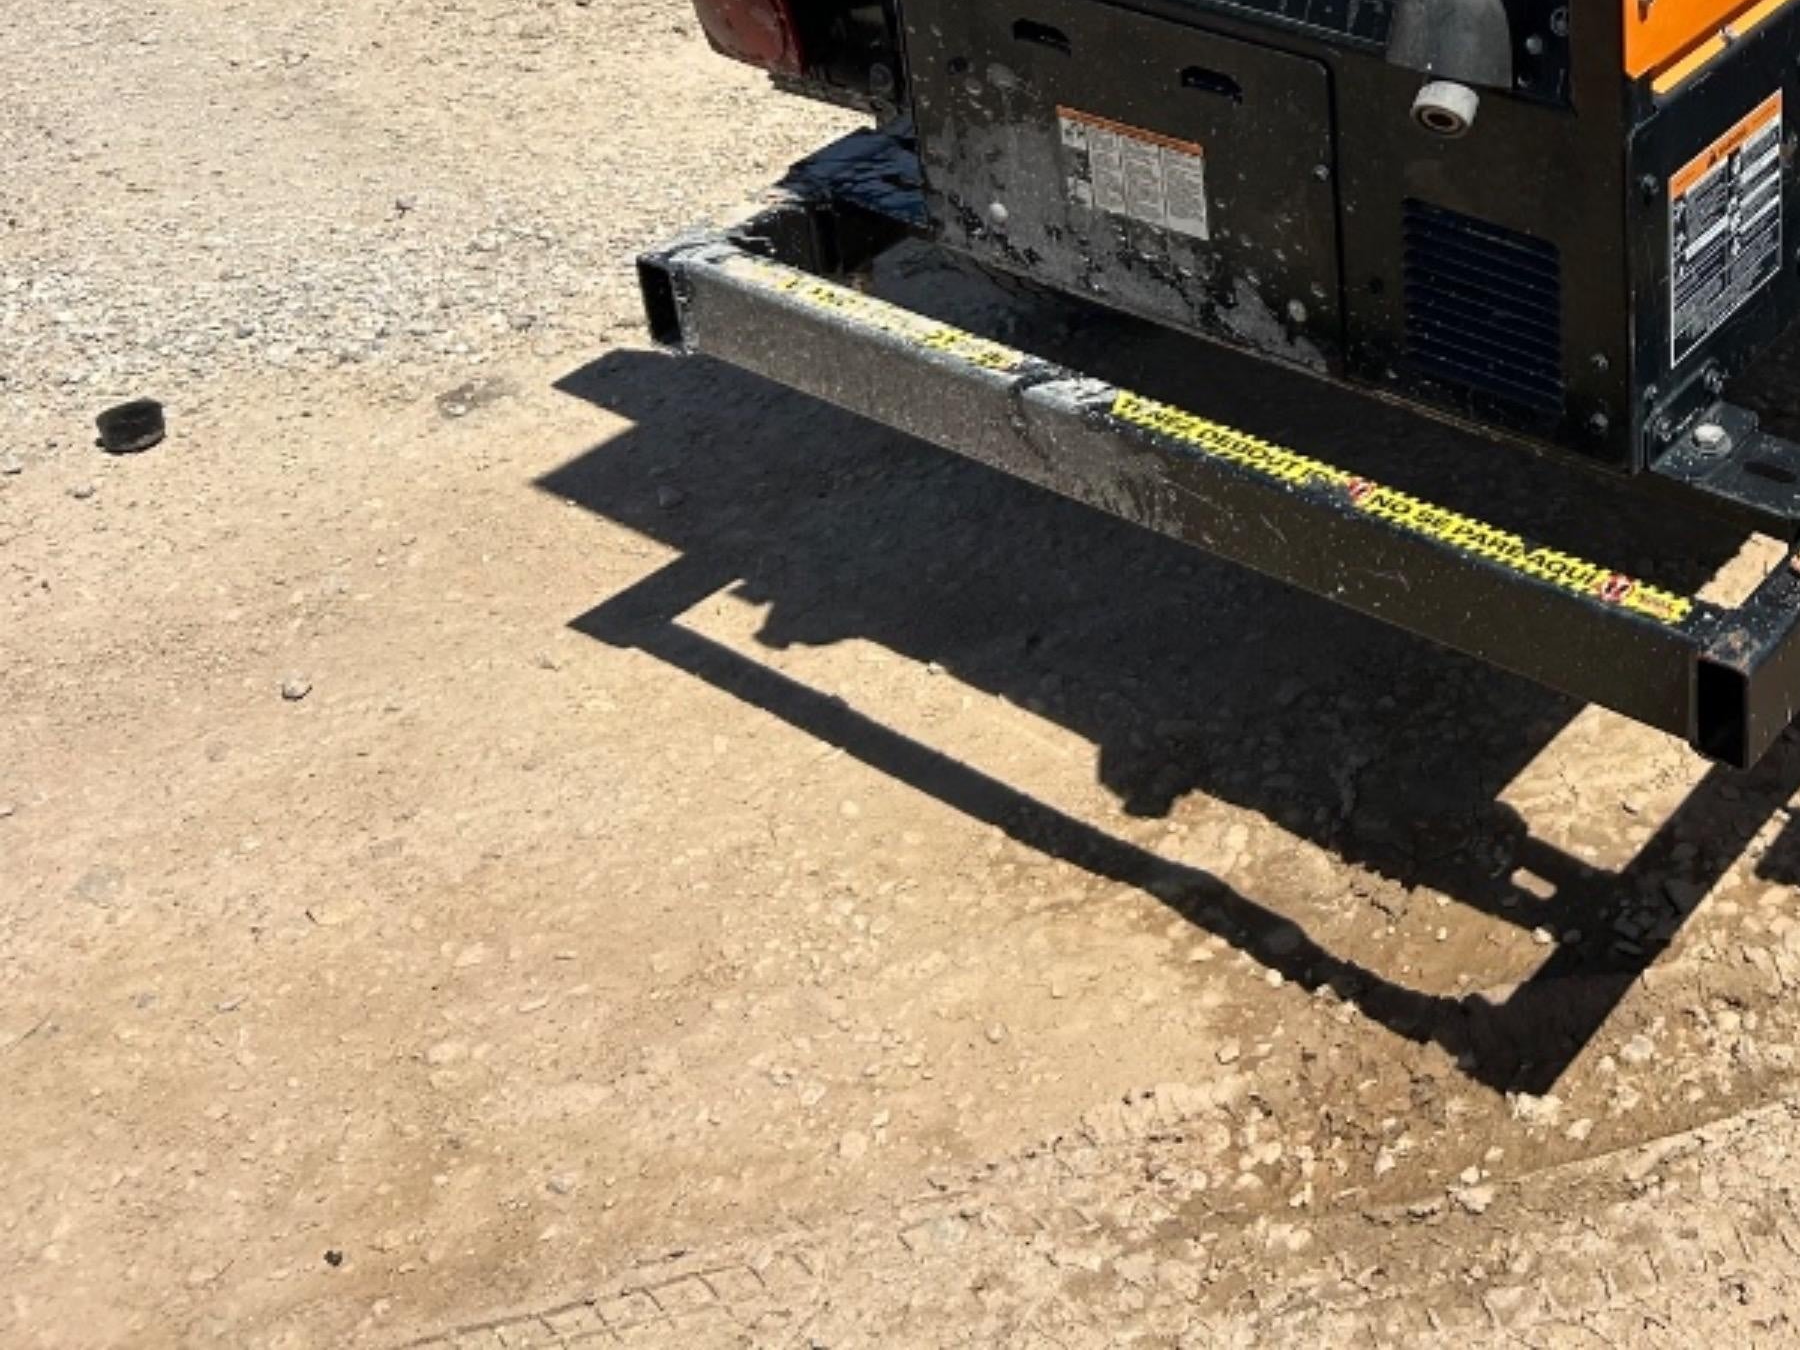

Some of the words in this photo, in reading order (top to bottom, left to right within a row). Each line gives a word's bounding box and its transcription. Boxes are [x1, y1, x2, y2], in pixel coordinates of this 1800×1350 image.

[1369, 493, 1412, 516] NO
[1414, 507, 1450, 531] SE
[1451, 523, 1523, 560] PARE
[1524, 552, 1597, 586] AQUI
